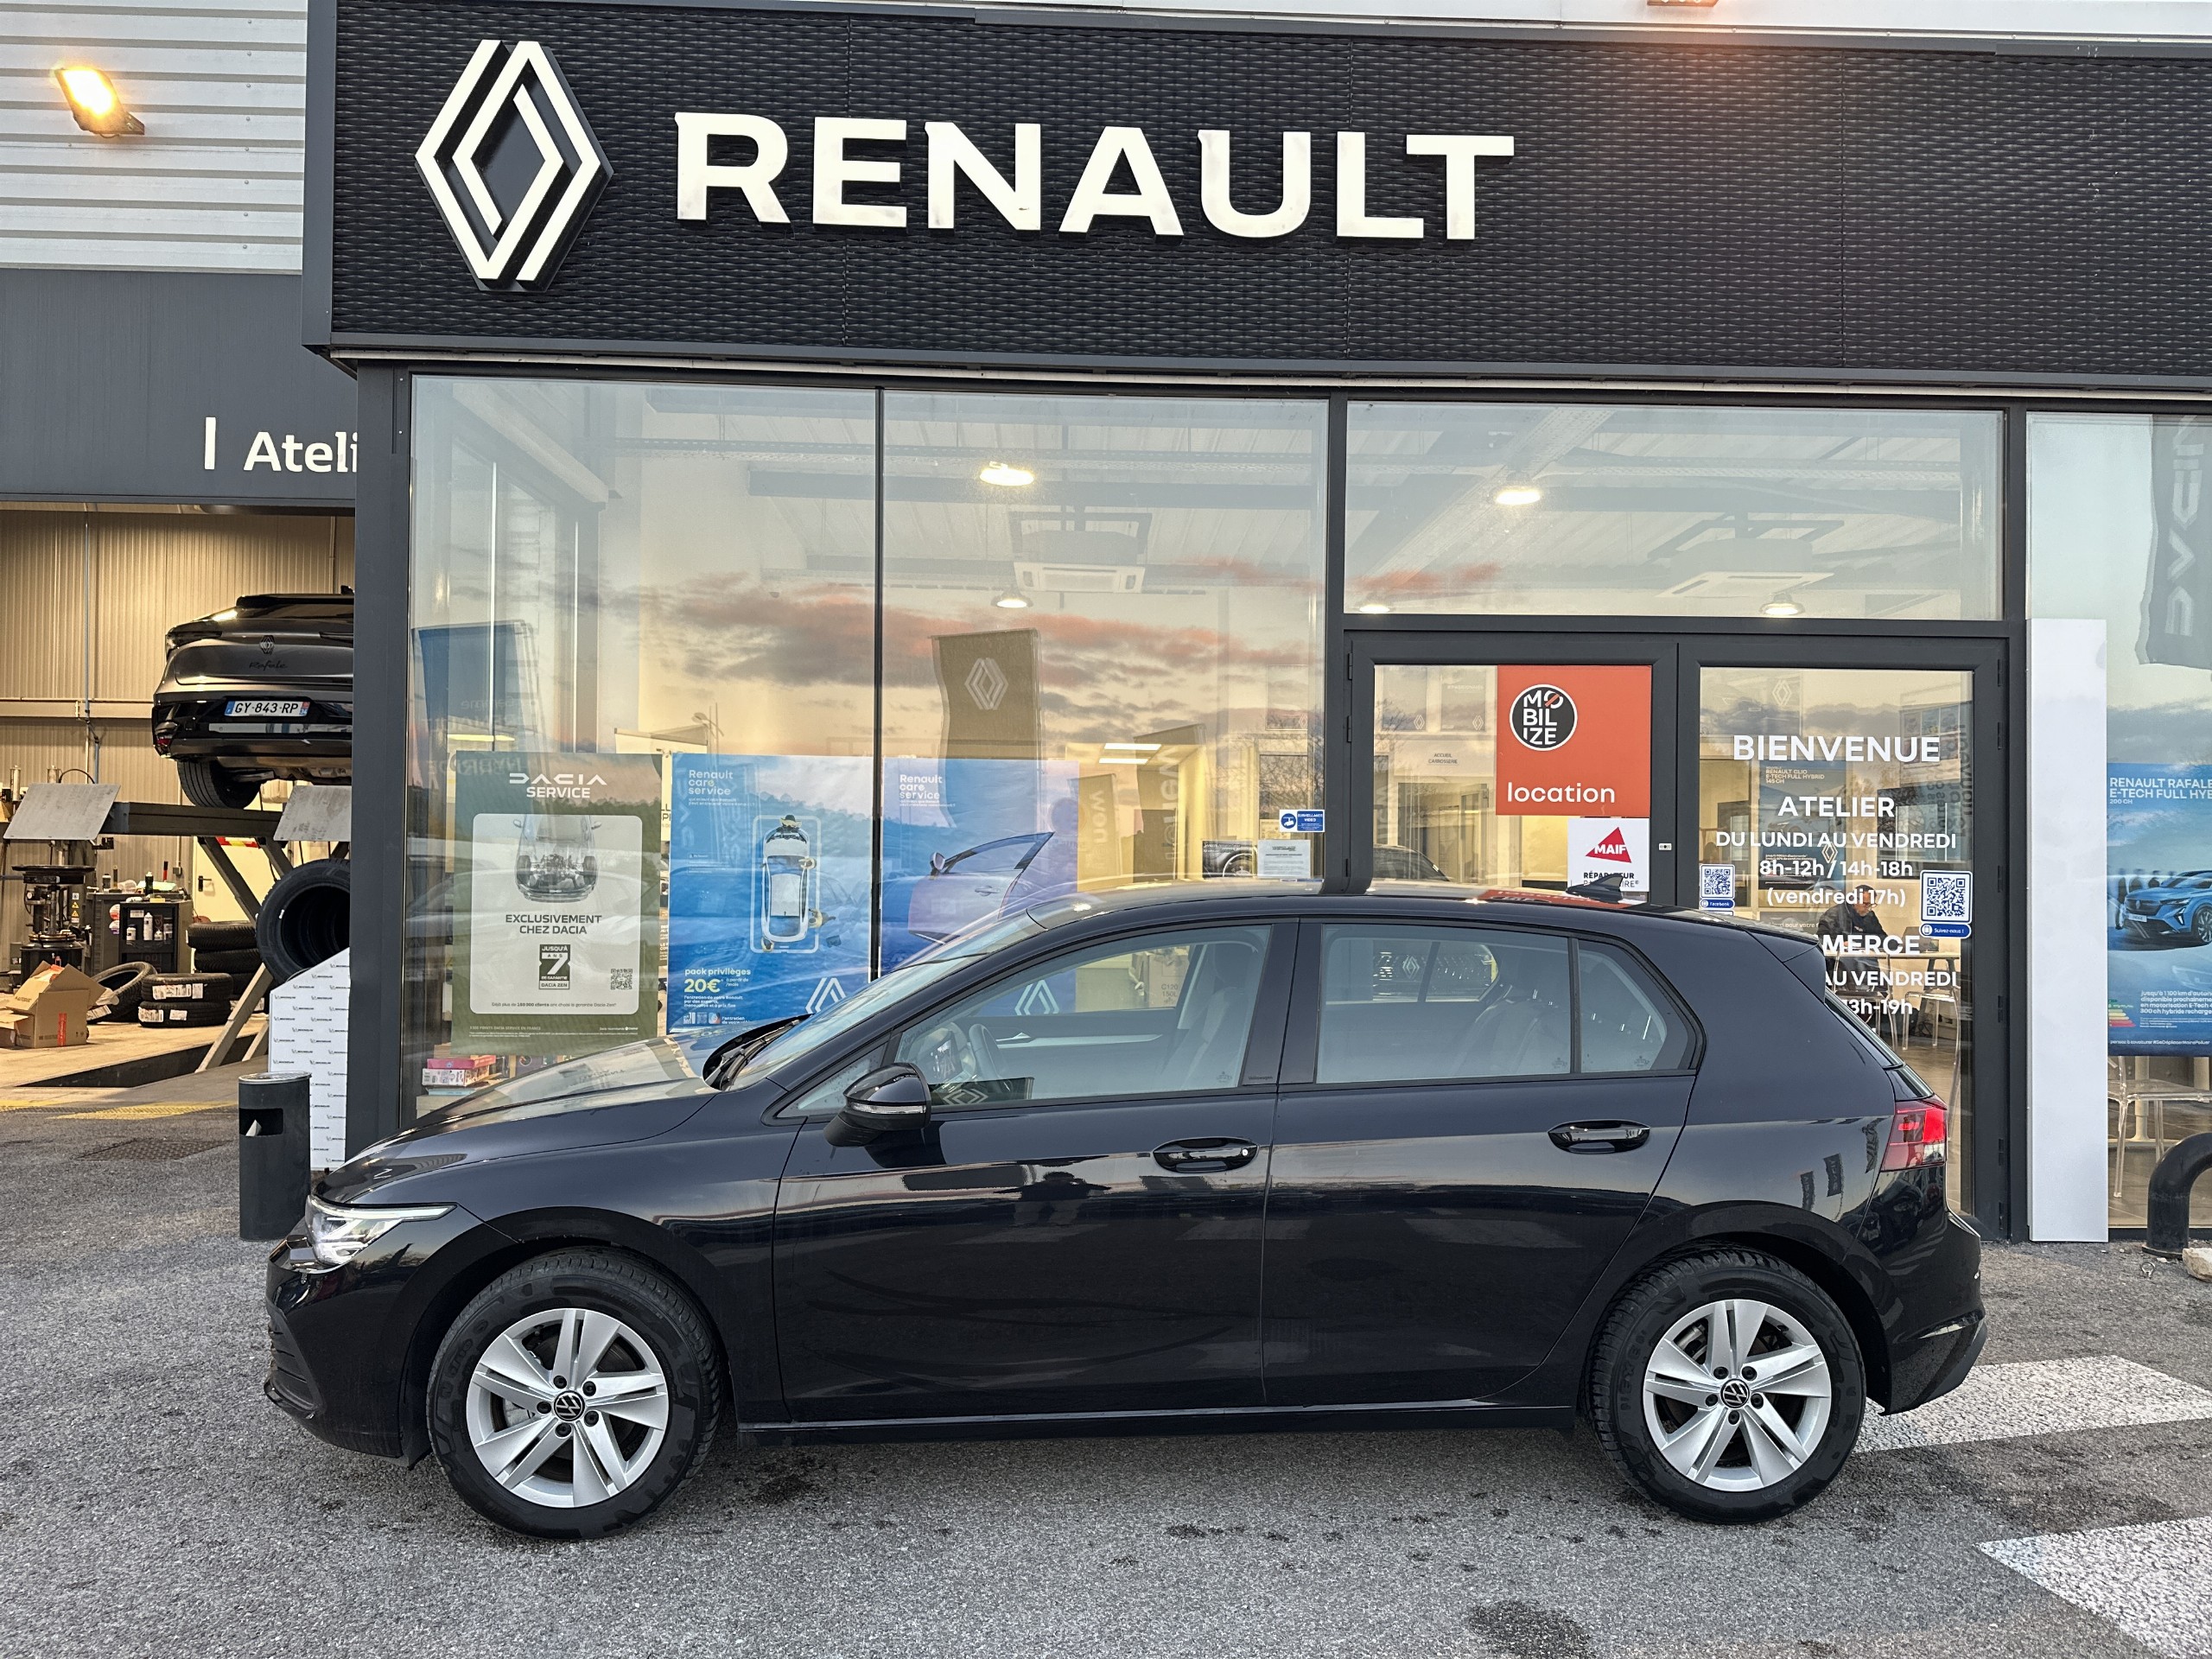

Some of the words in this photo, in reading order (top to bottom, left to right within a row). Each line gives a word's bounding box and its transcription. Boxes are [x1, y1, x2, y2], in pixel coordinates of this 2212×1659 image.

[674, 111, 1514, 240] RENAULT
[244, 431, 357, 473] Ateli
[249, 660, 288, 671] Rafale
[1733, 734, 1940, 762] BIENVENUE
[509, 772, 607, 785] DACIA
[689, 769, 734, 779] Renault
[899, 774, 943, 784] Renault
[688, 779, 715, 787] care
[2109, 777, 2165, 788] RENAULT
[2167, 779, 2212, 789] RAFALE
[526, 786, 590, 798] SERVICE
[688, 785, 731, 795] service
[899, 791, 940, 799] service
[1507, 781, 1615, 804] location
[2109, 788, 2154, 798] E-TECH
[2156, 789, 2187, 799] FULL
[1777, 796, 1895, 817] ATELIER
[1716, 831, 1745, 847] DU
[1750, 832, 1813, 848] LUNDI
[1816, 832, 1847, 848] AU
[1851, 833, 1956, 849] VENDREDI
[1594, 843, 1627, 855] MAIF
[1759, 860, 1825, 876] 8h-12h
[1841, 861, 1913, 877] 14h-18h
[1767, 887, 1865, 906] (vendredi
[1868, 888, 1906, 907] 17h)
[505, 914, 602, 924] EXCLUSIVEMENT
[518, 925, 550, 934] CHEZ
[552, 925, 588, 935] DACIA
[684, 968, 707, 976] pack
[709, 967, 752, 977] privilèges
[1850, 970, 1956, 987] VENDREDI
